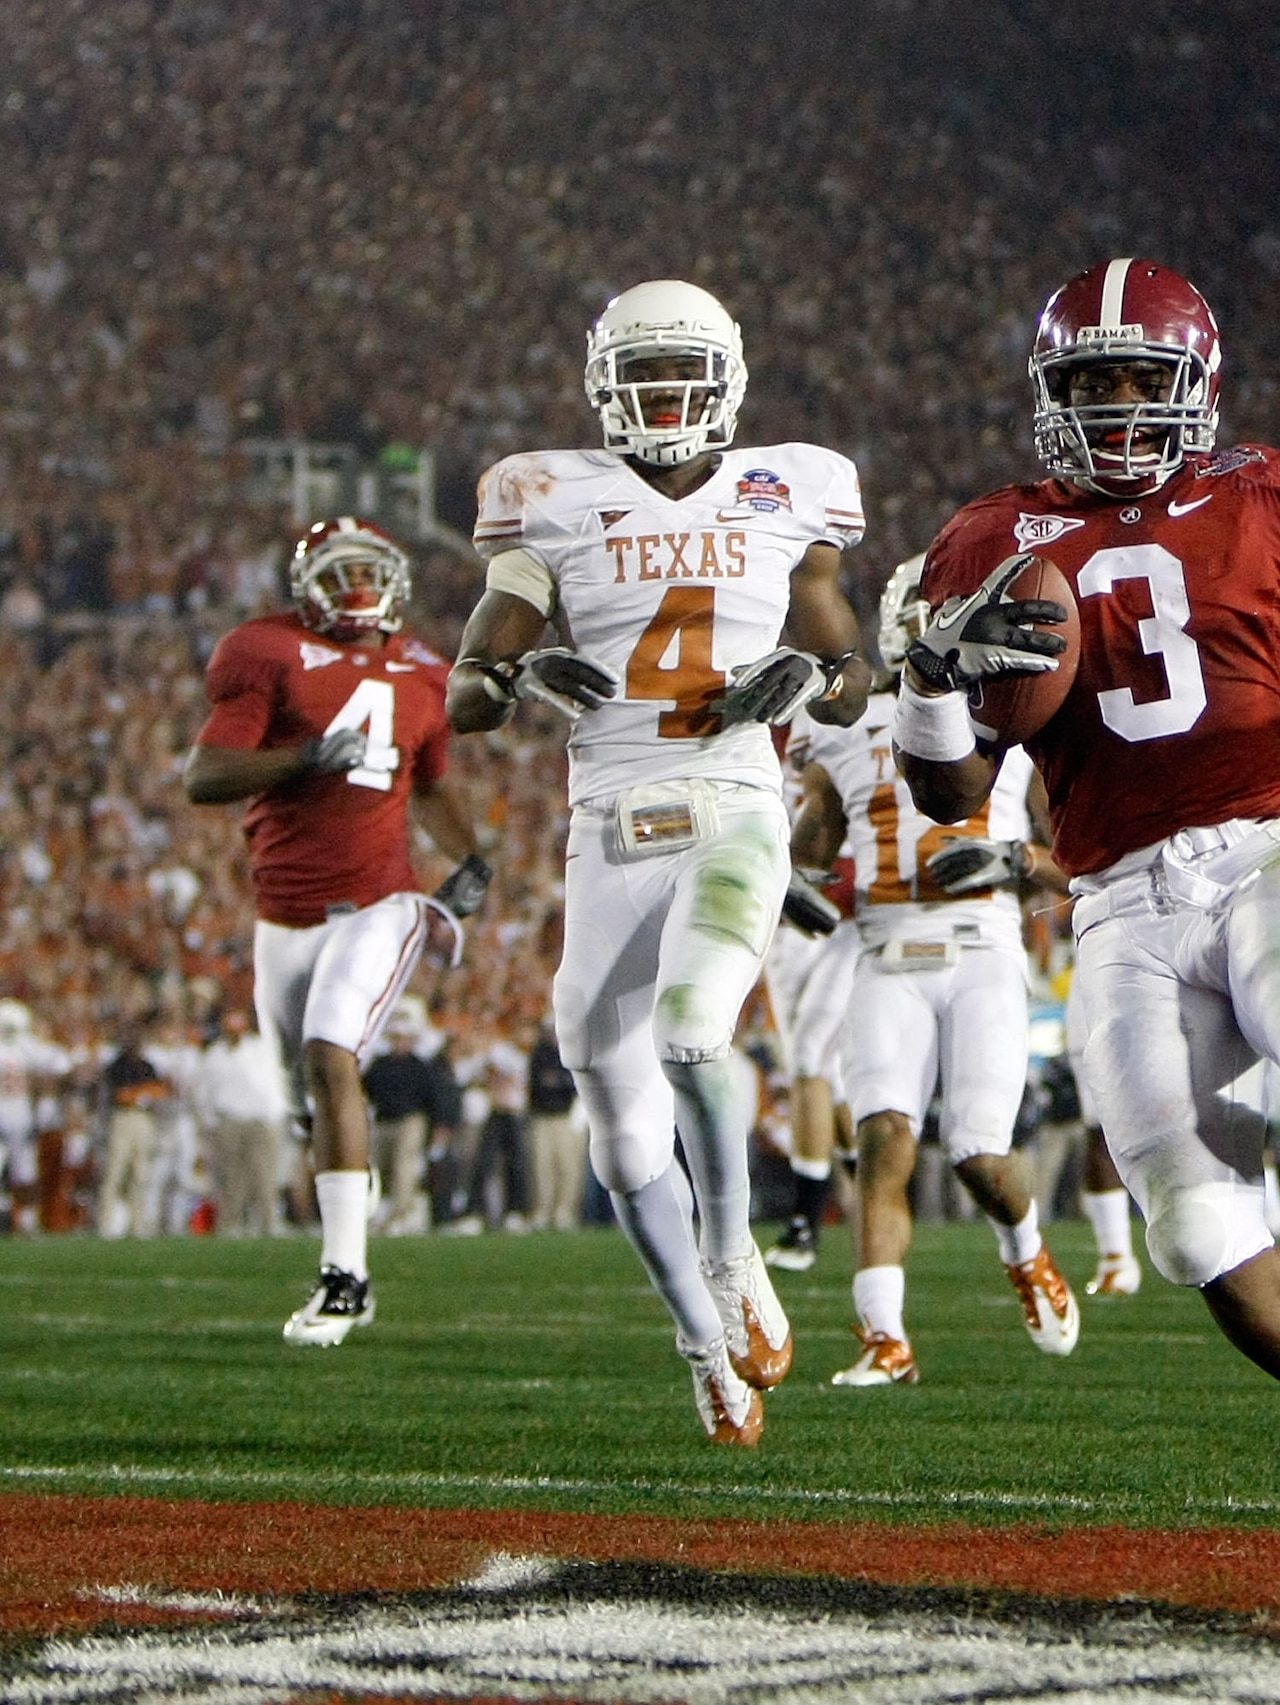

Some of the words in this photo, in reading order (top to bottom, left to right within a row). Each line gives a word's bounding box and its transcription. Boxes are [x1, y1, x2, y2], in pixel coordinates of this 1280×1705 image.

[1094, 329, 1127, 339] BAMA
[605, 532, 746, 584] TEXAS
[1030, 520, 1053, 538] SEC
[625, 586, 727, 738] 4
[1076, 543, 1208, 743] 3
[322, 678, 400, 793] 4
